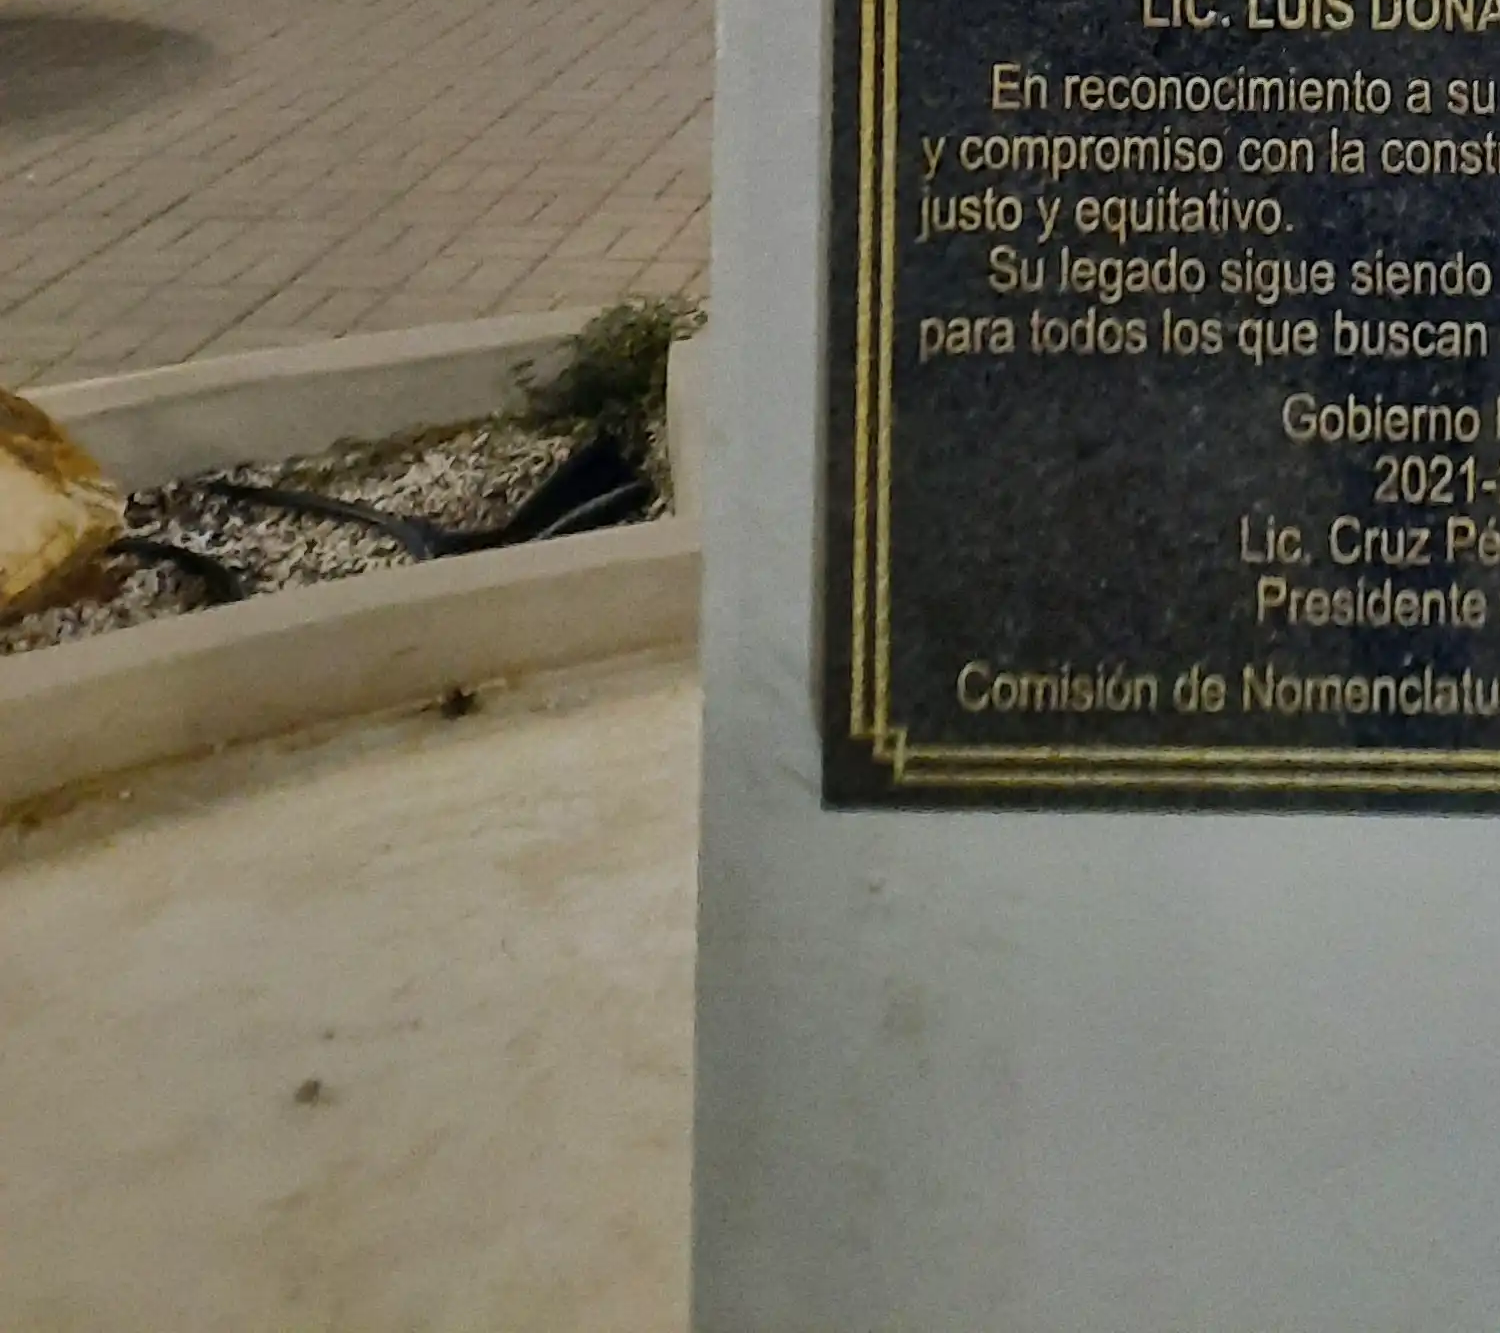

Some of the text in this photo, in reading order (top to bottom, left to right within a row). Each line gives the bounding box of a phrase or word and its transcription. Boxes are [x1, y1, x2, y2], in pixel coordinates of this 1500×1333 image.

[991, 64, 1048, 110] En
[1064, 68, 1392, 113] reconocimiento
[1406, 80, 1432, 113] a
[1447, 80, 1496, 115] su
[921, 138, 945, 179] y
[959, 127, 1222, 180] compromiso
[1239, 139, 1313, 174] con
[1330, 128, 1366, 174] la
[916, 189, 1294, 242] justo y equitativo.
[988, 246, 1043, 294] Su
[1060, 247, 1205, 301] legado
[1219, 250, 1334, 302] sigue
[1351, 250, 1492, 296] siendo
[919, 318, 1014, 361] para
[1031, 311, 1146, 355] todos
[1163, 311, 1221, 355] los
[1238, 320, 1317, 364] que
[1334, 311, 1489, 358] buscan
[1283, 394, 1480, 445] Gobierno
[1240, 518, 1310, 565] Lic.
[1329, 518, 1430, 565] Cruz
[1257, 580, 1485, 627] Presidente
[956, 660, 1158, 712] Comisión
[1173, 663, 1225, 712] de
